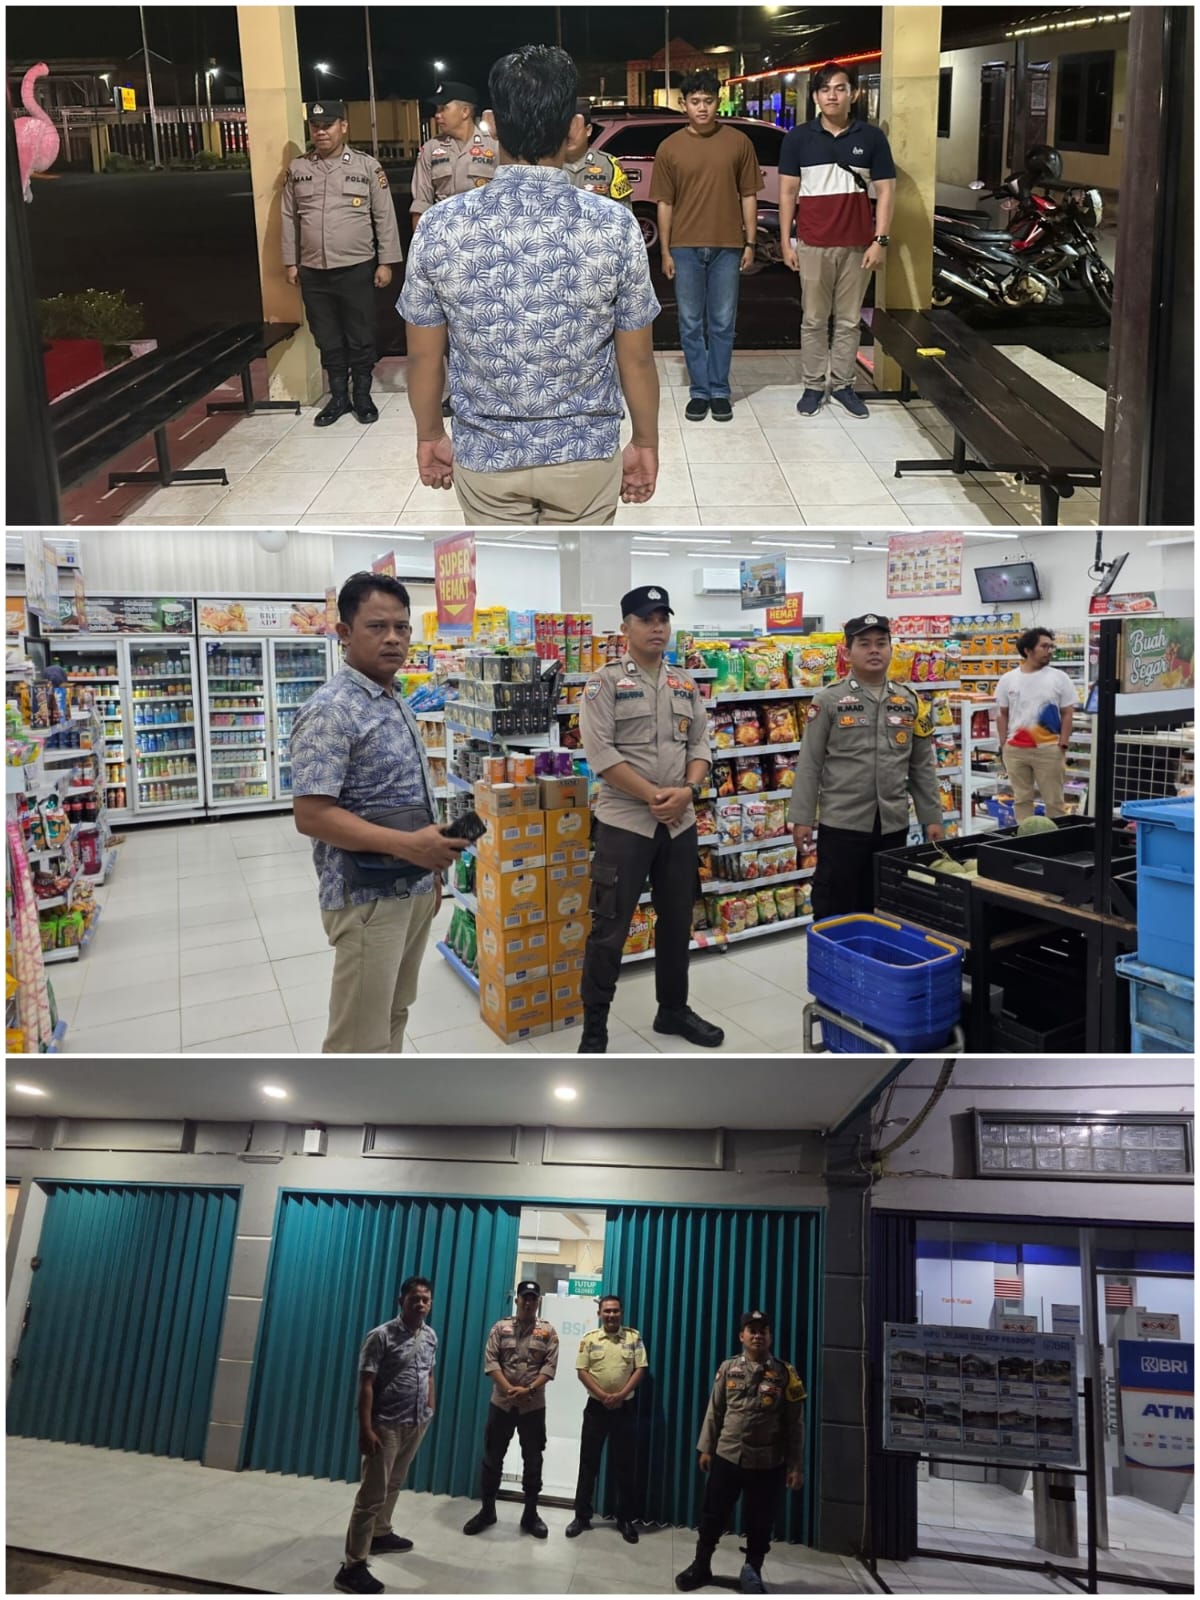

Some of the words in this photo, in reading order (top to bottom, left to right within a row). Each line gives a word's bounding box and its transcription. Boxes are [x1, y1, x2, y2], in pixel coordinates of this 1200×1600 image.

[439, 548, 470, 578] SUPER
[439, 576, 470, 601] HEMAT
[769, 608, 797, 620] HEMAT
[1130, 628, 1167, 656] Buah
[1130, 657, 1168, 686] Segar
[1160, 1359, 1188, 1374] BRI
[1142, 1403, 1194, 1421] ATM
